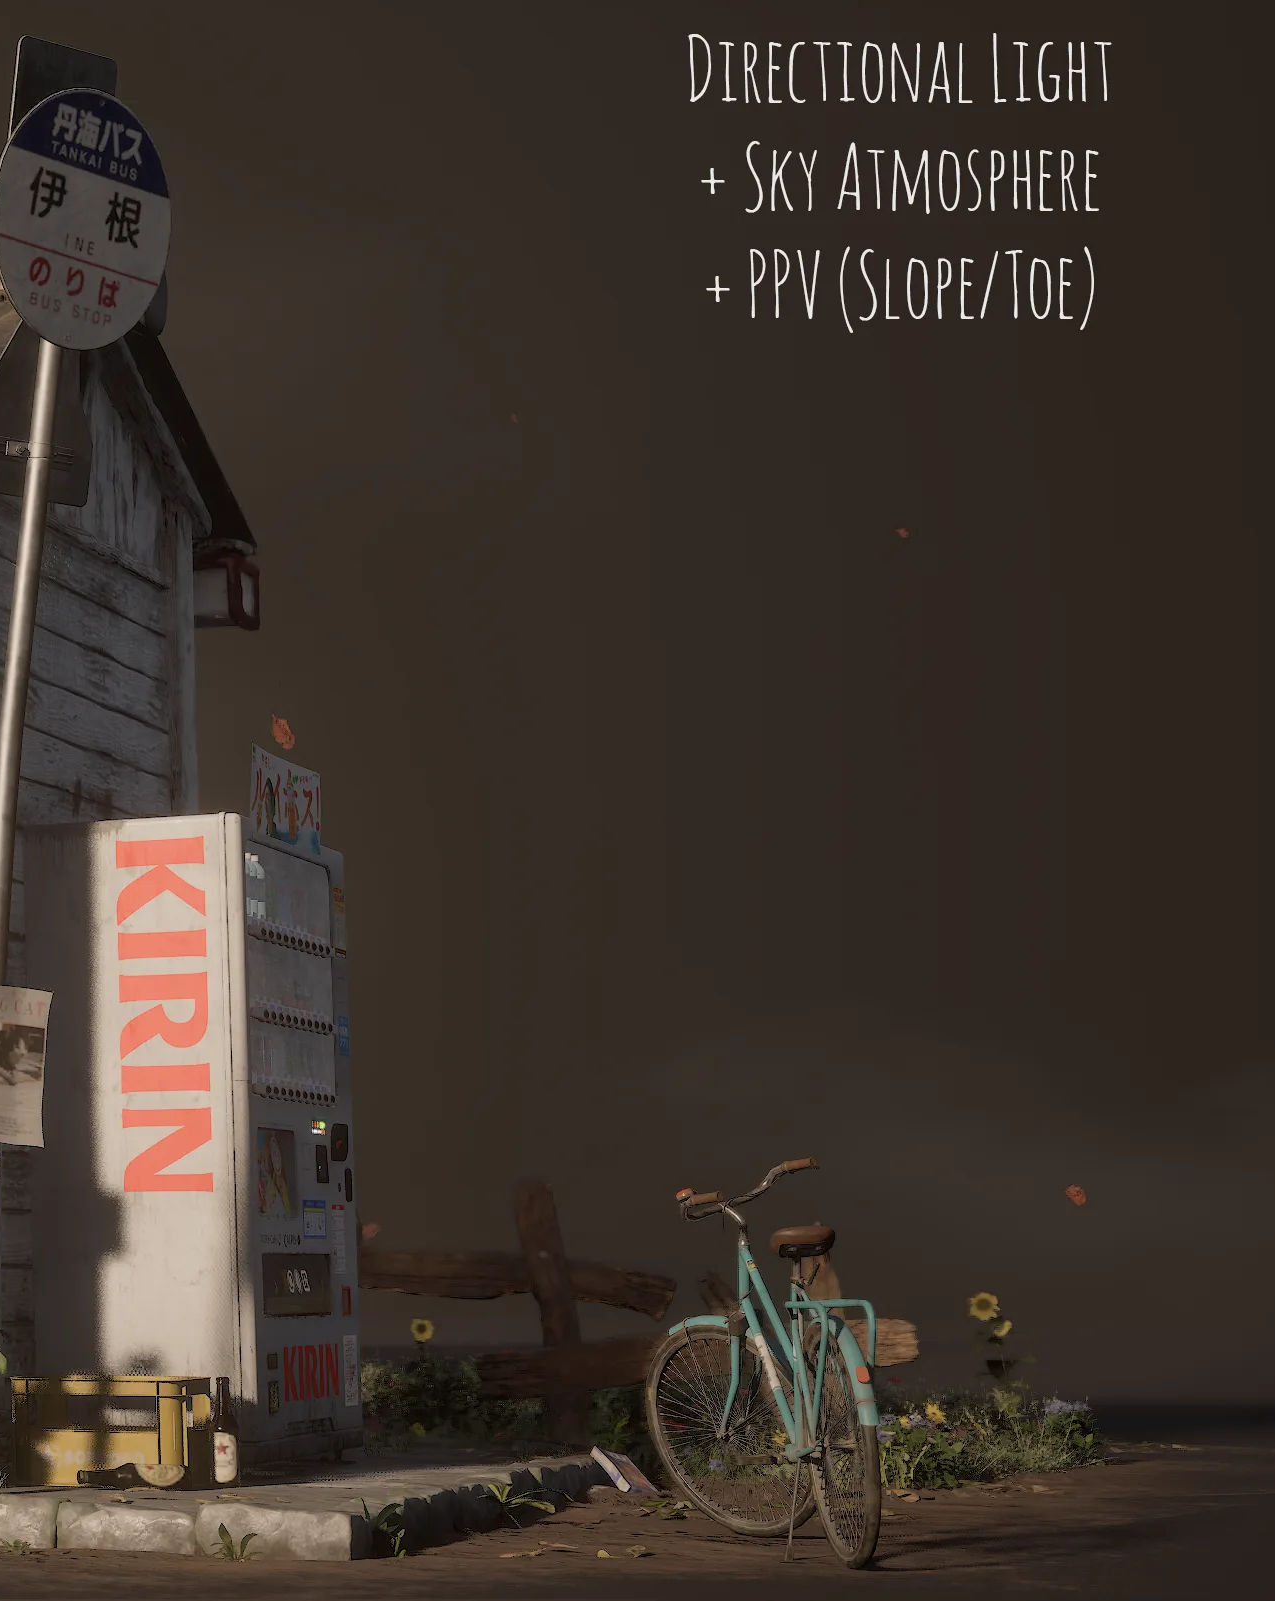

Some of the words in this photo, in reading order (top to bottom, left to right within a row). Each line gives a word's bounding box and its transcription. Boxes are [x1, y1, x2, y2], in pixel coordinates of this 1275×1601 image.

[51, 102, 143, 166] 丹海バス
[51, 140, 103, 171] TANKAI
[109, 161, 139, 182] BUS
[64, 233, 95, 256] INE
[29, 257, 121, 308] のりば
[29, 292, 62, 313] BUS
[72, 304, 112, 328] STOP
[14, 998, 47, 1017] CAT
[115, 836, 214, 1193] KIRIN
[283, 1343, 341, 1403] KIRIN
